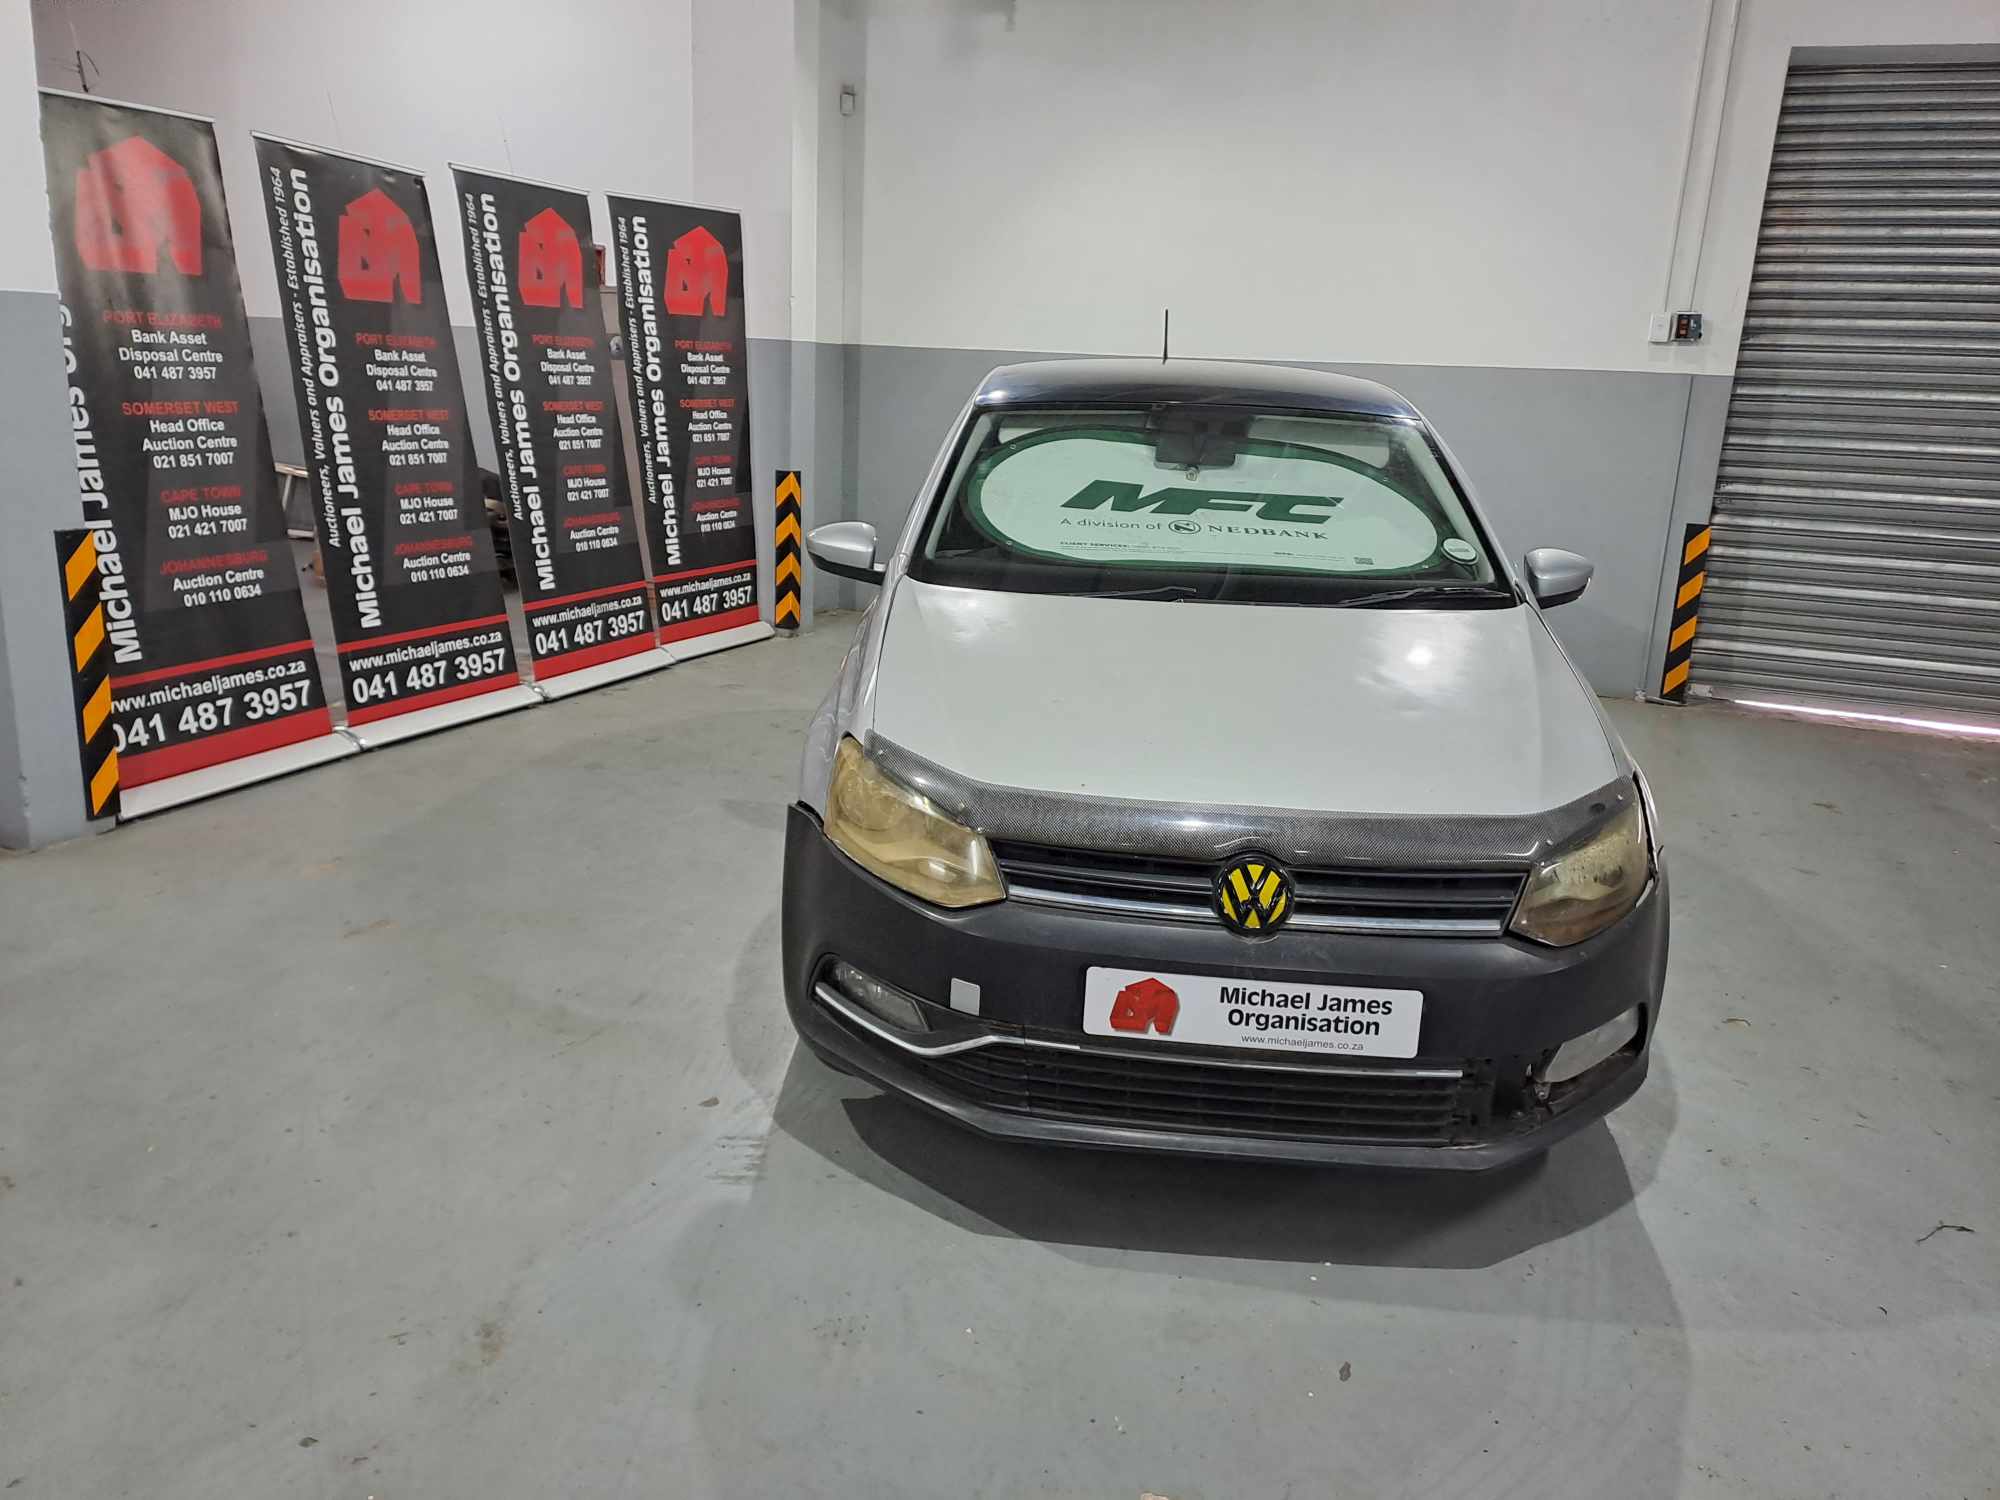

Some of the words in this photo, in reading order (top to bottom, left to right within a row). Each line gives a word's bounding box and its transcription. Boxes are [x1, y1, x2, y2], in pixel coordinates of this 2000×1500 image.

[270, 166, 286, 202] 1964
[465, 193, 478, 224] 1964
[618, 217, 627, 244] 1964
[275, 206, 299, 290] Established
[472, 227, 488, 298] Established
[290, 168, 339, 387] Organisation
[480, 192, 520, 382] Organisation
[620, 246, 635, 309] Established
[632, 216, 662, 382] Organisation
[103, 310, 143, 323] PORT
[132, 329, 167, 344] Bank
[170, 331, 207, 345] Asset
[293, 301, 313, 376] Appraisers
[482, 306, 499, 372] Appraisers
[630, 318, 643, 372] Appraisers
[119, 347, 178, 363] Disposal
[182, 349, 223, 362] Centre
[374, 349, 399, 361] Bank
[402, 350, 426, 362] Asset
[134, 366, 157, 379] 041
[161, 367, 183, 379] 487
[188, 367, 216, 379] 3957
[366, 364, 408, 377] Disposal
[410, 365, 437, 377] Centre
[376, 380, 392, 391] 041
[396, 380, 411, 391] 487
[633, 374, 644, 396] and
[302, 378, 317, 406] and
[492, 375, 503, 399] and
[122, 401, 199, 415] SOMERSET
[204, 400, 240, 414] WEST
[639, 400, 650, 437] Valuers
[150, 420, 184, 433] Head
[187, 418, 224, 431] Office
[308, 409, 326, 460] Valuers
[387, 424, 411, 436] Head
[414, 424, 440, 435] Office
[499, 402, 510, 444] Valuers
[510, 390, 536, 479] James
[651, 389, 671, 467] James
[69, 386, 109, 509] James
[142, 438, 193, 451] Auction
[197, 436, 237, 448] Centre
[326, 396, 359, 499] James
[382, 440, 419, 451] Auction
[421, 439, 449, 449] Centre
[153, 456, 176, 468] 021
[180, 454, 202, 466] 851
[206, 452, 233, 465] 7007
[389, 455, 406, 466] 021
[408, 454, 424, 464] 851
[427, 453, 447, 463] 7007
[645, 440, 656, 504] Auctioneers,
[160, 489, 197, 502] CAPE
[204, 485, 240, 498] TOWN
[505, 448, 524, 520] Auctioneers,
[169, 506, 198, 521] MJO
[201, 504, 242, 517] House
[320, 465, 341, 548] Auctioneers,
[400, 497, 422, 509] MJO
[424, 497, 453, 508] House
[400, 513, 417, 525] 021
[419, 512, 435, 523] 421
[437, 509, 458, 521] 7007
[1060, 480, 1345, 524] MFC
[168, 525, 190, 538] 021
[194, 522, 216, 536] 421
[220, 518, 247, 532] 7007
[658, 474, 681, 565] Michael
[1077, 519, 1140, 529] division
[1146, 522, 1161, 530] of
[1208, 525, 1328, 540] NEDBANK
[523, 486, 556, 590] Michael
[341, 507, 382, 628] Michael
[403, 554, 438, 569] Auction
[441, 552, 470, 564] Centre
[173, 574, 222, 592] Auction
[225, 568, 264, 583] Centre
[411, 571, 428, 583] 010
[429, 569, 445, 580] 110
[660, 573, 751, 598] www.michaeljames.co.za
[84, 519, 143, 664] Michael
[184, 592, 206, 607] 010
[209, 588, 231, 602] 110
[234, 584, 262, 599] 0634
[662, 599, 689, 621] 041
[693, 594, 717, 614] 487
[723, 586, 752, 608] 3957
[532, 596, 642, 627] www.michaeljames.co.za
[535, 628, 567, 655] 041
[574, 621, 602, 645] 487
[609, 611, 645, 637] 3957
[350, 631, 502, 672] www.michaeljames.co.za
[353, 671, 398, 703] 041
[407, 661, 447, 690] 487
[454, 648, 505, 680] 3957
[178, 698, 233, 735] 487
[243, 679, 310, 720] 3957
[1220, 986, 1311, 1009] Michael
[1317, 994, 1392, 1015] James
[1228, 1008, 1380, 1035] Organisation
[1241, 1035, 1364, 1050] www.michaeljames.co.za
